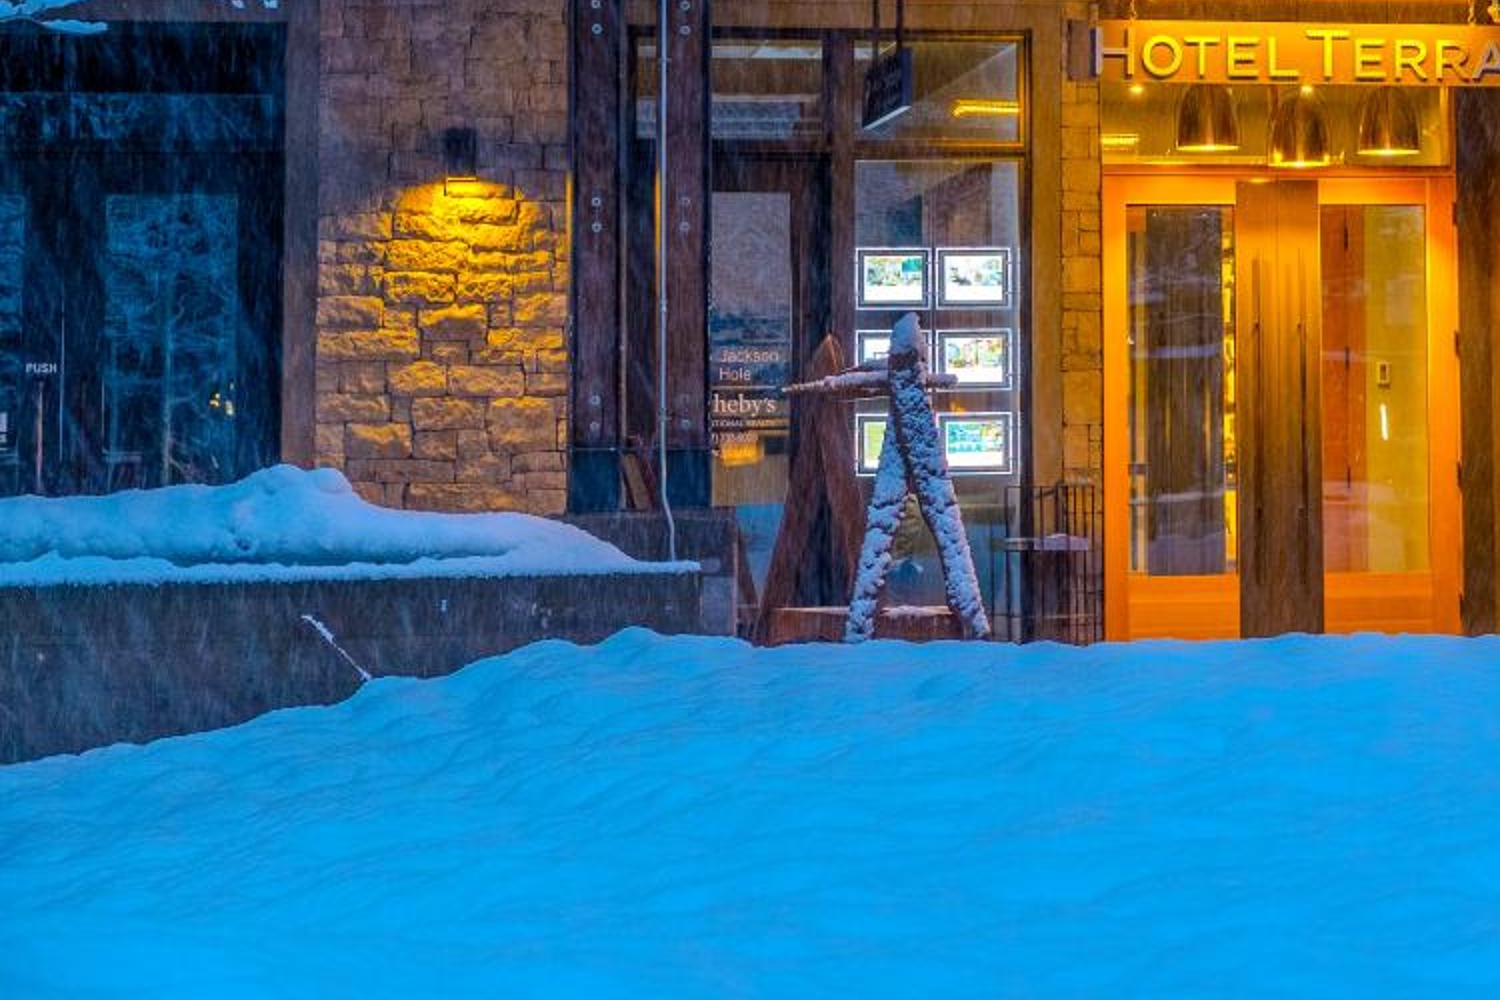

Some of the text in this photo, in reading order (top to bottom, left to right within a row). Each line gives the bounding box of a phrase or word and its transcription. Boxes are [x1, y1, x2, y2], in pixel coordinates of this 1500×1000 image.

[1095, 24, 1300, 79] HOTEL
[721, 349, 779, 362] Jackson
[25, 362, 57, 373] PUSH
[719, 367, 751, 381] Hole
